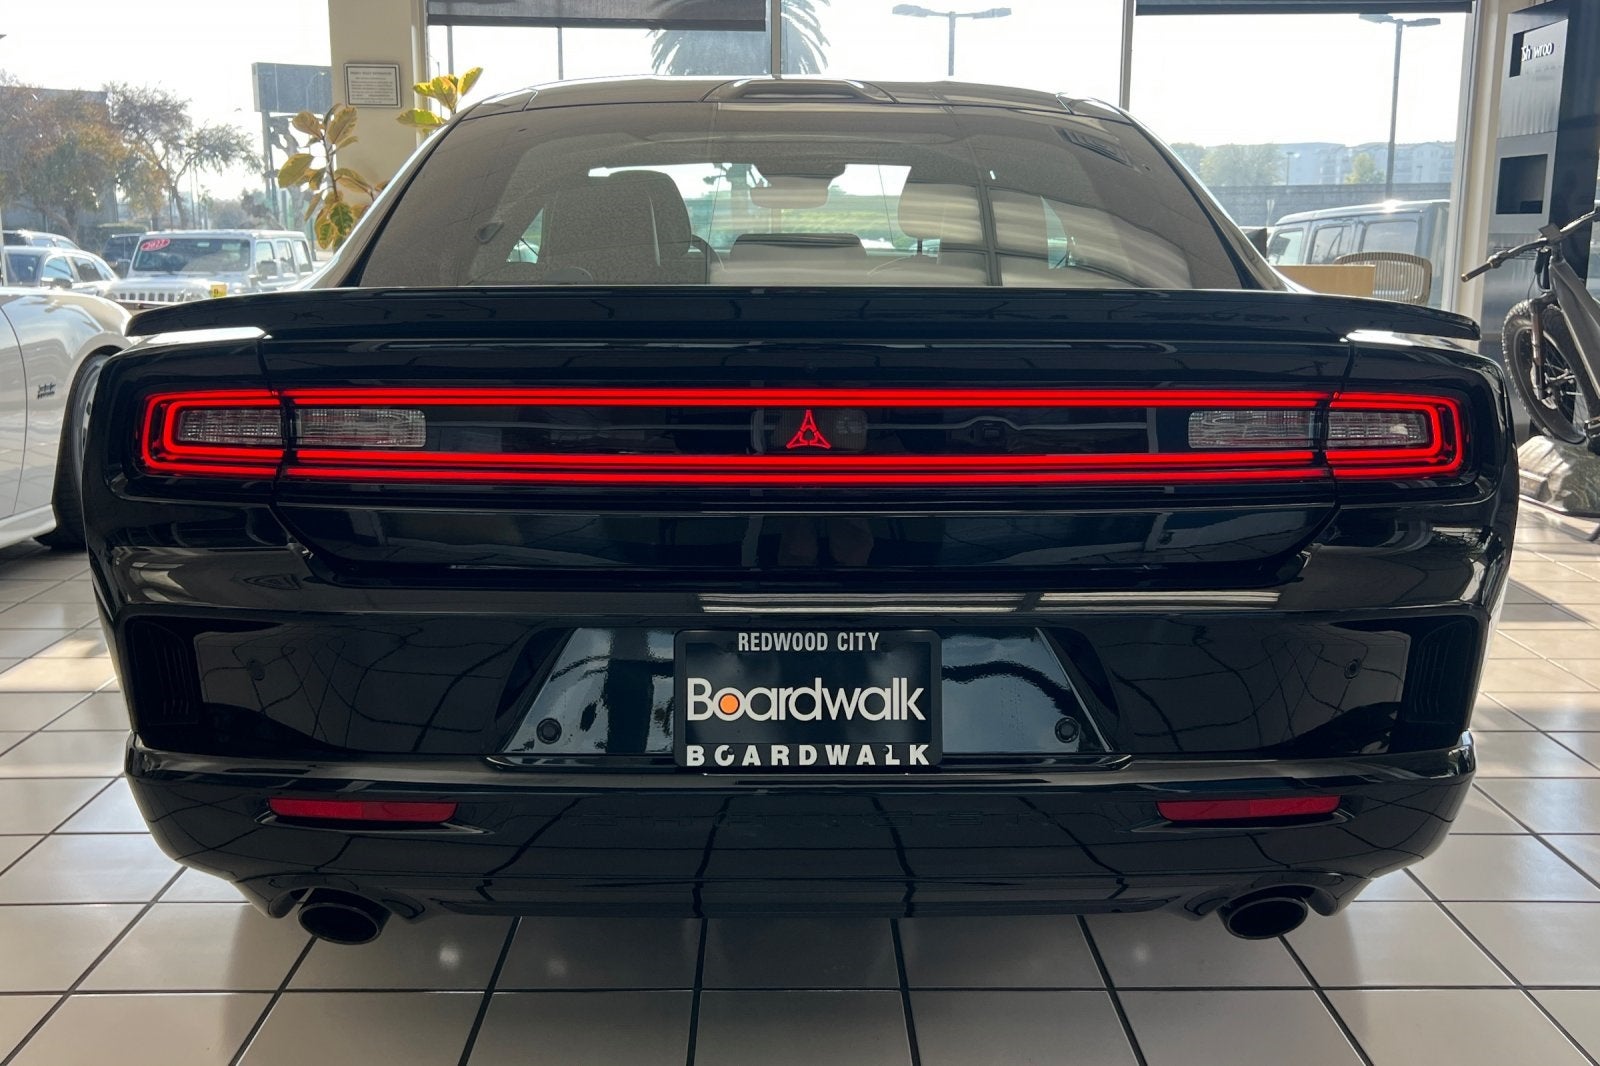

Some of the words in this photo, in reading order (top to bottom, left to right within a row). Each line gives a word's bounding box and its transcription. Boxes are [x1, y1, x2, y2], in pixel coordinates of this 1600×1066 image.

[738, 632, 828, 651] REDWOOD
[837, 632, 880, 651] CITY
[687, 677, 926, 721] Boardwalk
[687, 744, 930, 766] BOARDWALK
